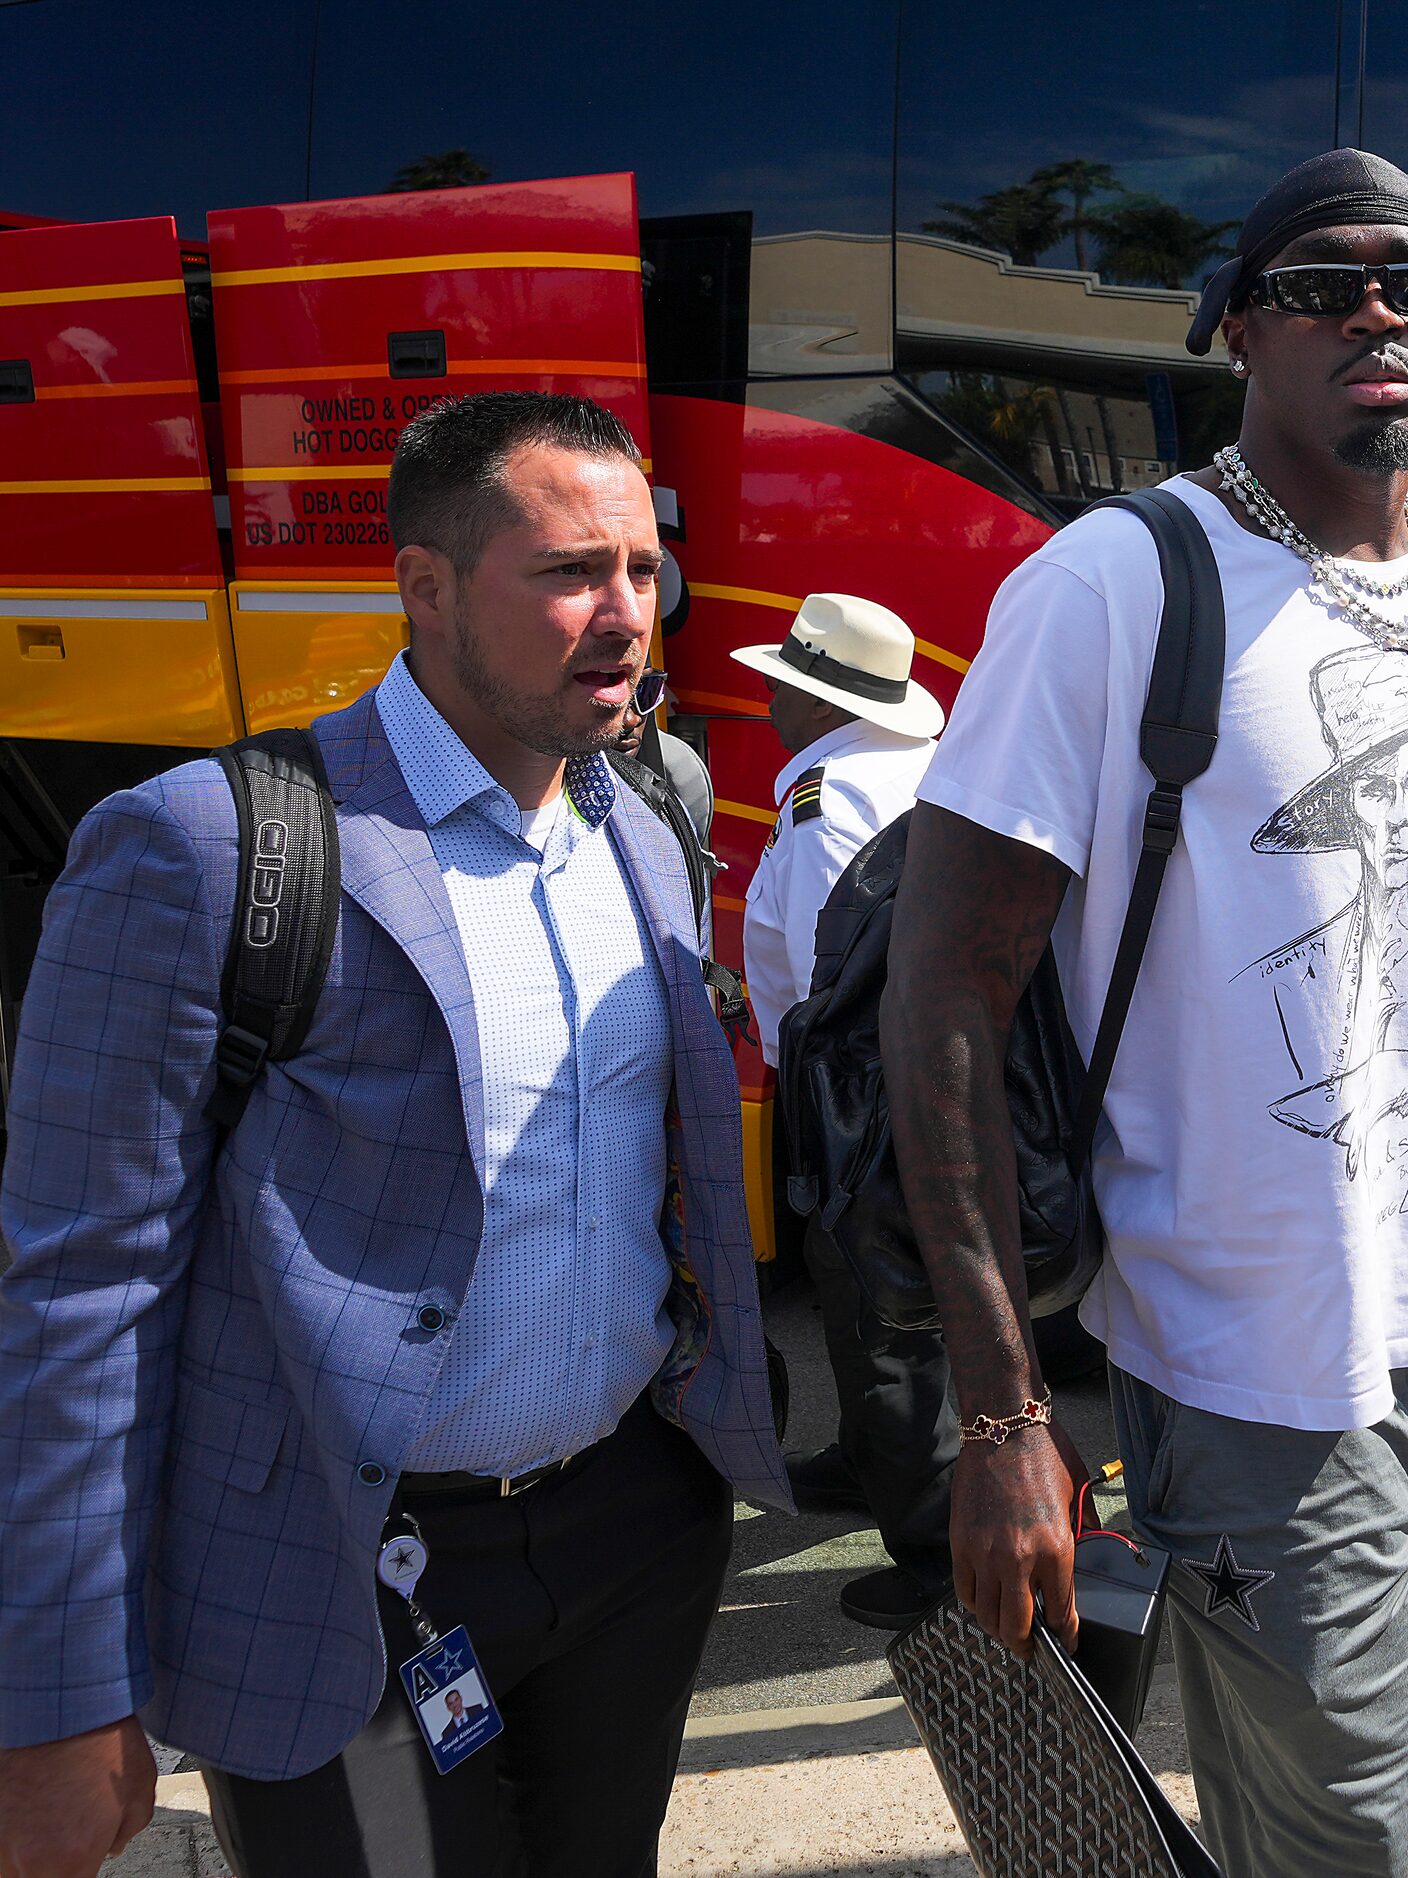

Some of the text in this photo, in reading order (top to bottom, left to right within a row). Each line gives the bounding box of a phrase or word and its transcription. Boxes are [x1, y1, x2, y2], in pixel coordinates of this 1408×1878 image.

[302, 398, 375, 423] OWNED
[383, 397, 396, 420] &
[293, 430, 333, 453] HOT
[303, 491, 342, 514] DBA
[247, 522, 273, 545] US
[278, 521, 317, 545] DOT
[247, 820, 288, 947] OGIO
[1333, 1048, 1345, 1063] do
[412, 1662, 438, 1704] A
